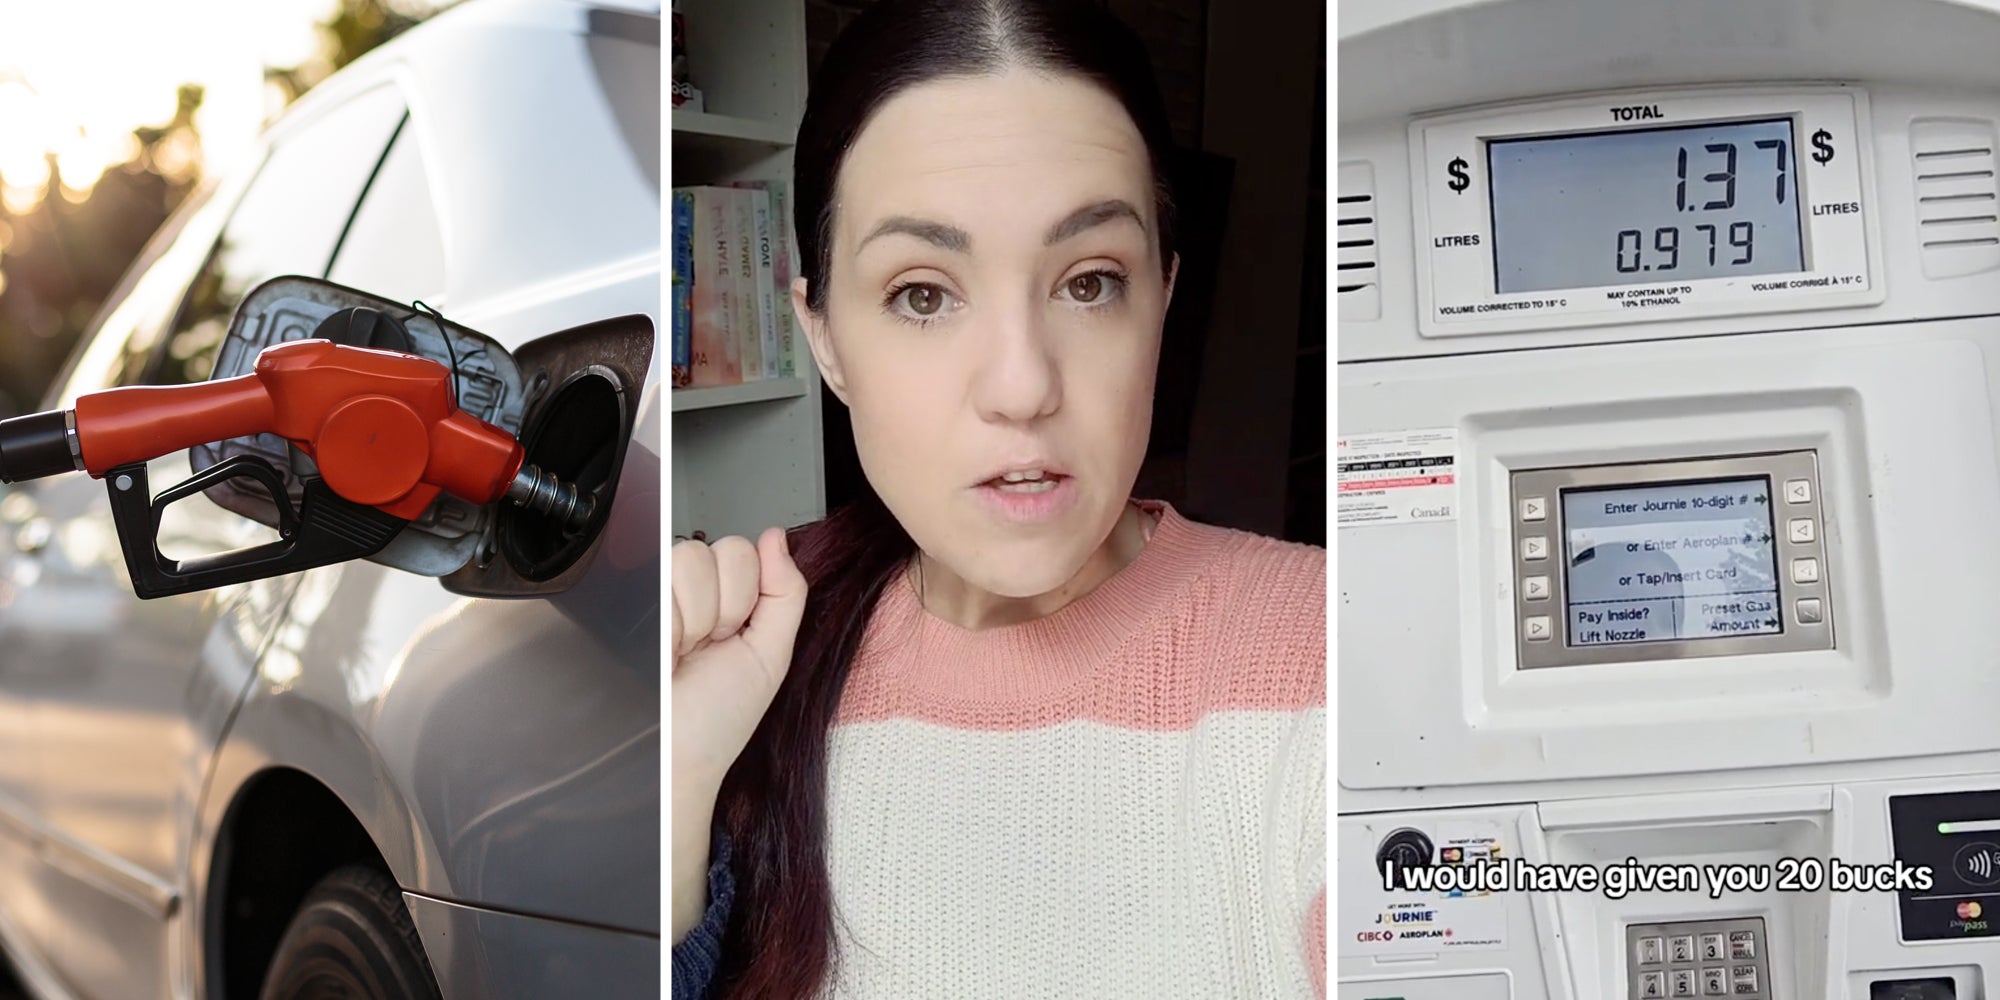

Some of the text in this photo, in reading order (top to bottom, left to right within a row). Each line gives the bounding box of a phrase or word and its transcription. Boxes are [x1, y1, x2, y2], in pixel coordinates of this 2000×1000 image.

[1610, 105, 1663, 122] TOTAL
[1811, 129, 1834, 166] $
[1447, 156, 1471, 195] $
[1676, 139, 1786, 213] 1.37
[1812, 202, 1860, 216] LITRES
[1434, 234, 1481, 248] LITRES
[1616, 221, 1754, 274] 0.979
[1751, 282, 1788, 291] VOLUME
[1789, 278, 1830, 289] CORRIGÉ
[1607, 286, 1692, 300] MAY CONTAIN UP TO
[1439, 305, 1475, 315] VOLUME
[1477, 300, 1531, 313] CORRECTED
[1532, 301, 1544, 309] TO
[1621, 297, 1681, 309] 10% ETHANOL
[1605, 502, 1638, 515] Enter
[1642, 499, 1687, 512] Journie
[1692, 495, 1734, 510] 10-digit
[1626, 542, 1639, 553] or
[1644, 539, 1677, 551] Enter
[1682, 535, 1738, 549] Aeroplan
[1619, 567, 1737, 587] or Tap/Insert Card
[1702, 602, 1742, 615] Preset
[1578, 607, 1650, 625] Pay Inside?
[1710, 619, 1761, 633] Amount
[1580, 628, 1646, 643] Lift Nozzle
[1375, 911, 1433, 924] JOURNIE
[1357, 930, 1444, 942] CIBC AEROPLAN
[1673, 939, 1688, 947] ABC
[1677, 947, 1685, 959] 2
[1707, 945, 1716, 958] 3
[1647, 983, 1656, 995] 4
[1679, 982, 1687, 993] 5
[1711, 979, 1719, 991] 6
